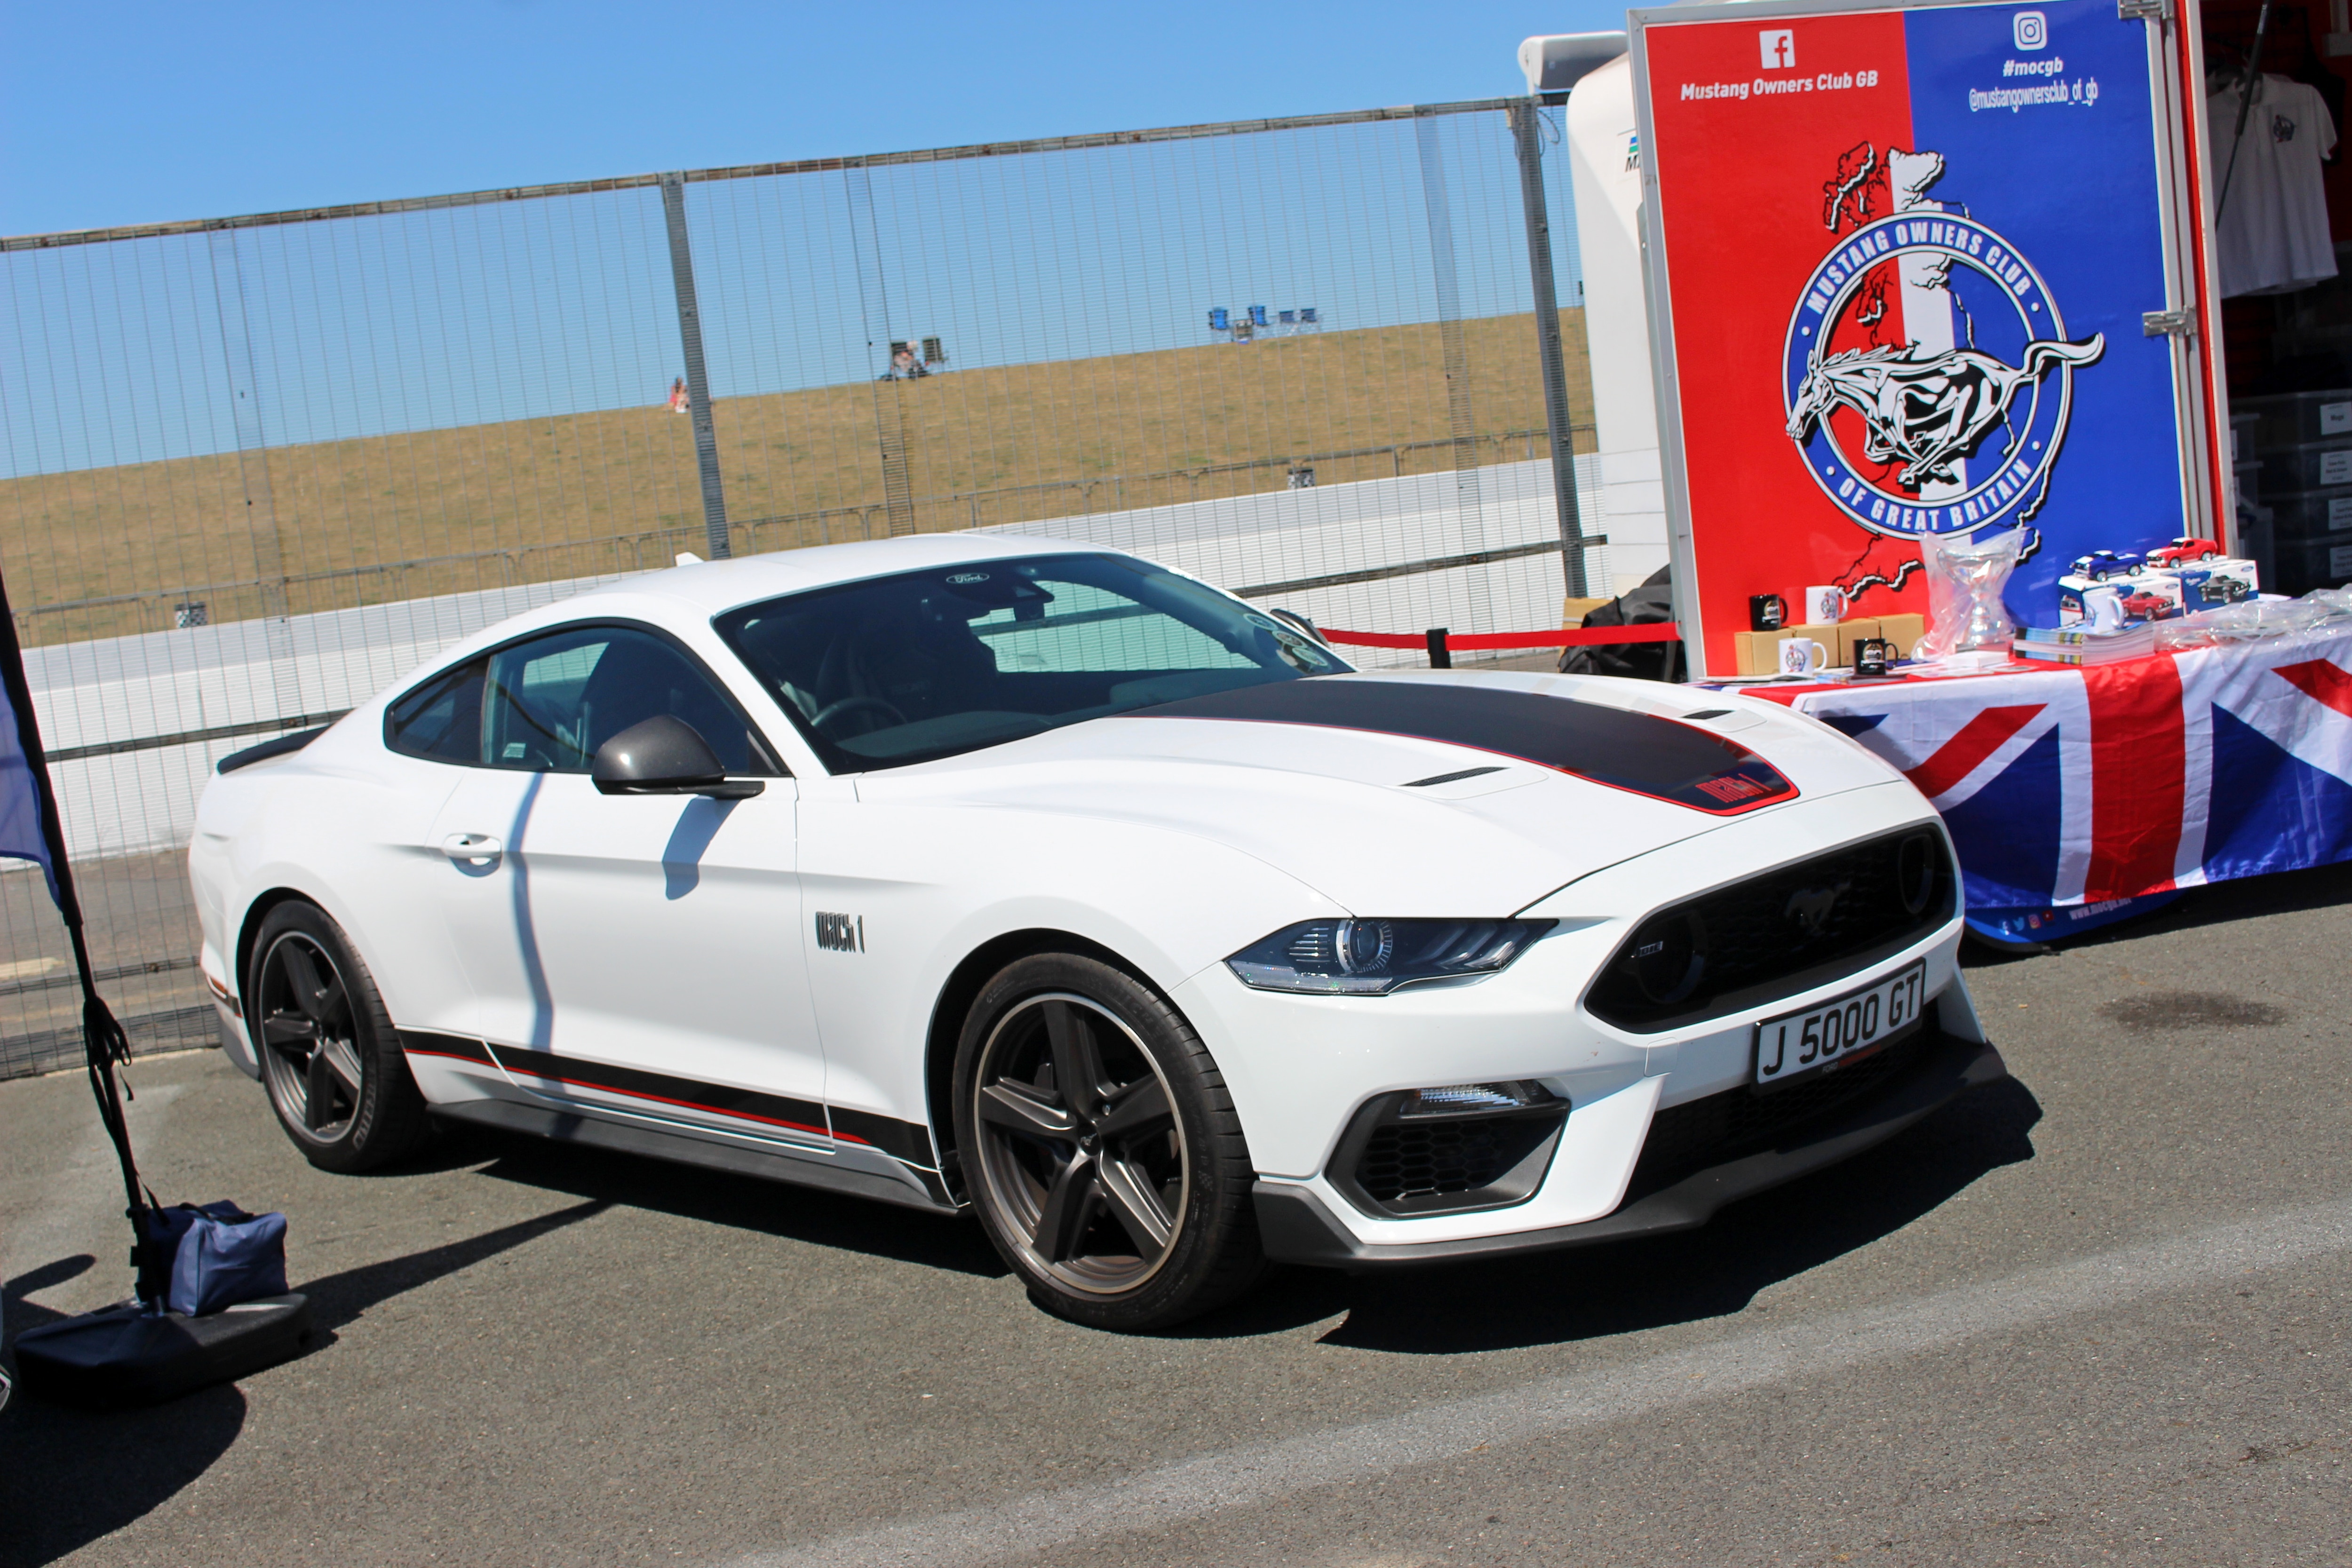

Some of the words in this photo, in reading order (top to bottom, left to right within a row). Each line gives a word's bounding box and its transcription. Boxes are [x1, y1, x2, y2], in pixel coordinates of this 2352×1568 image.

[1681, 82, 1749, 101] Mustang
[1752, 78, 1813, 95] Owners
[1817, 72, 1852, 90] Club
[1856, 70, 1878, 88] GB
[2002, 56, 2064, 77] #mocgb
[1969, 77, 2098, 113] @mustangownersclub_of_gb
[1805, 230, 1890, 315] MUSTANG
[1895, 222, 1983, 255] OWNERS
[1985, 245, 2031, 296] CLUB
[1838, 477, 1867, 507] OF
[1870, 499, 1939, 531] GREAT
[1949, 459, 2032, 527] BRITAIN
[857, 915, 865, 954] 1
[1763, 1026, 1786, 1076] J
[1799, 993, 1879, 1064] 5000
[1889, 971, 1919, 1027] GT
